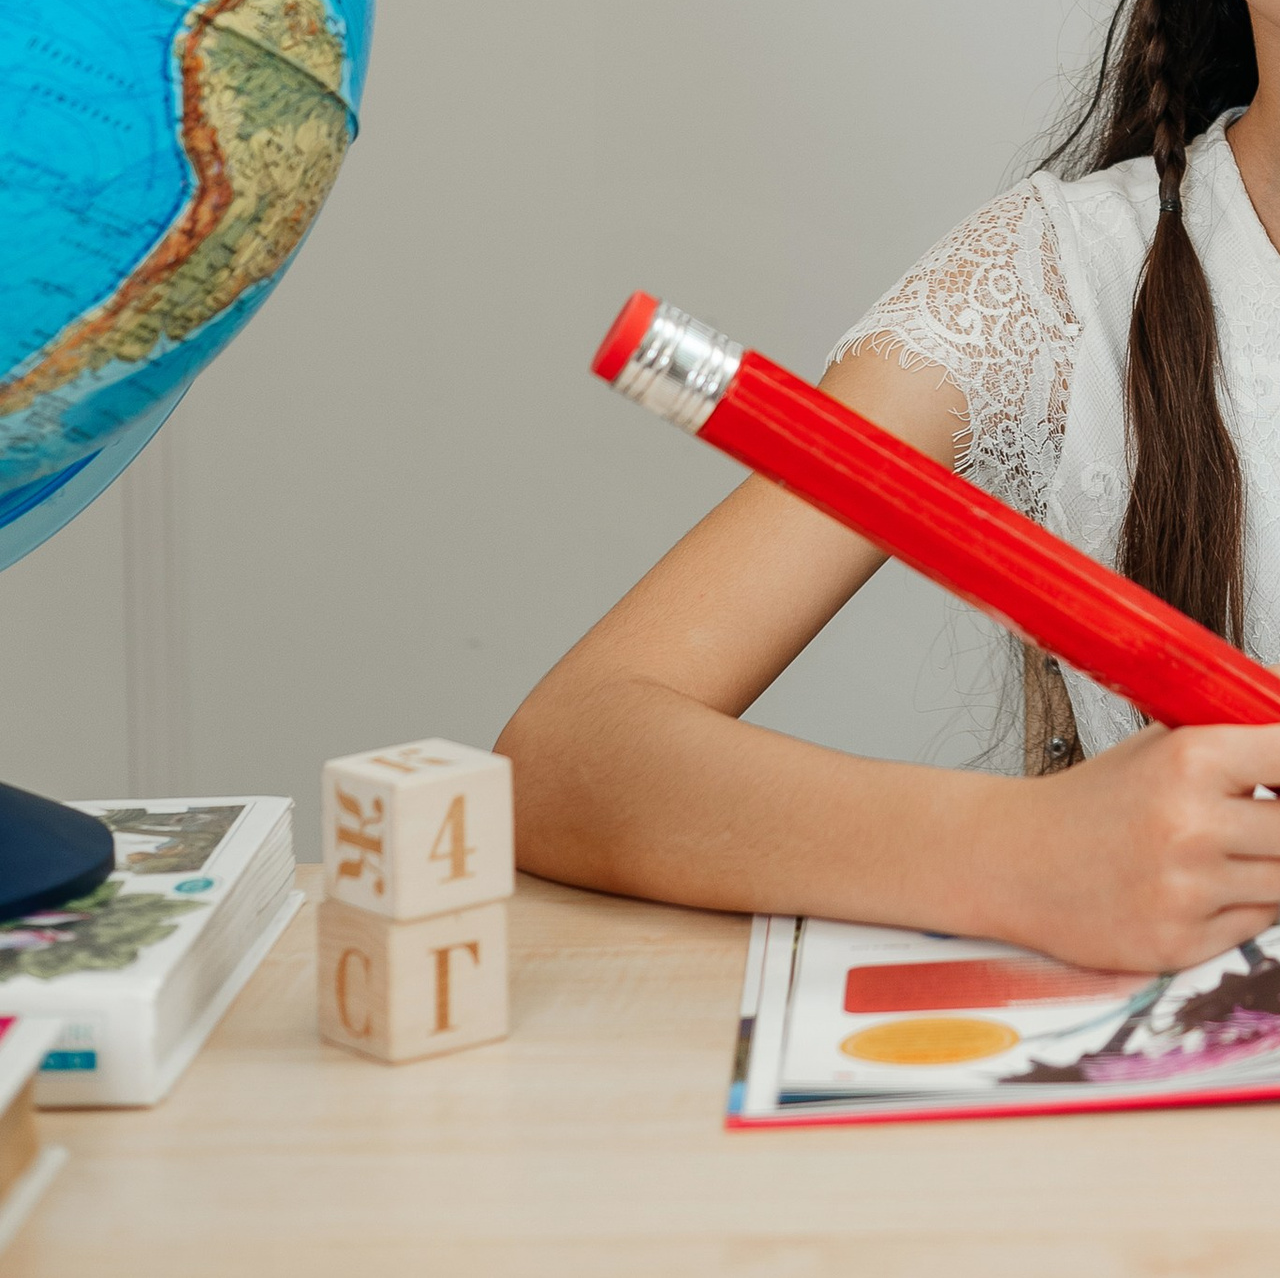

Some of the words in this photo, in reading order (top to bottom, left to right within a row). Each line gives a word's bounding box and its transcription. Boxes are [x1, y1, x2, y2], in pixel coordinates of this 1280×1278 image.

[335, 780, 385, 898] Ж
[427, 794, 477, 886] 4
[335, 947, 372, 1039] С
[427, 940, 481, 1036] Г
